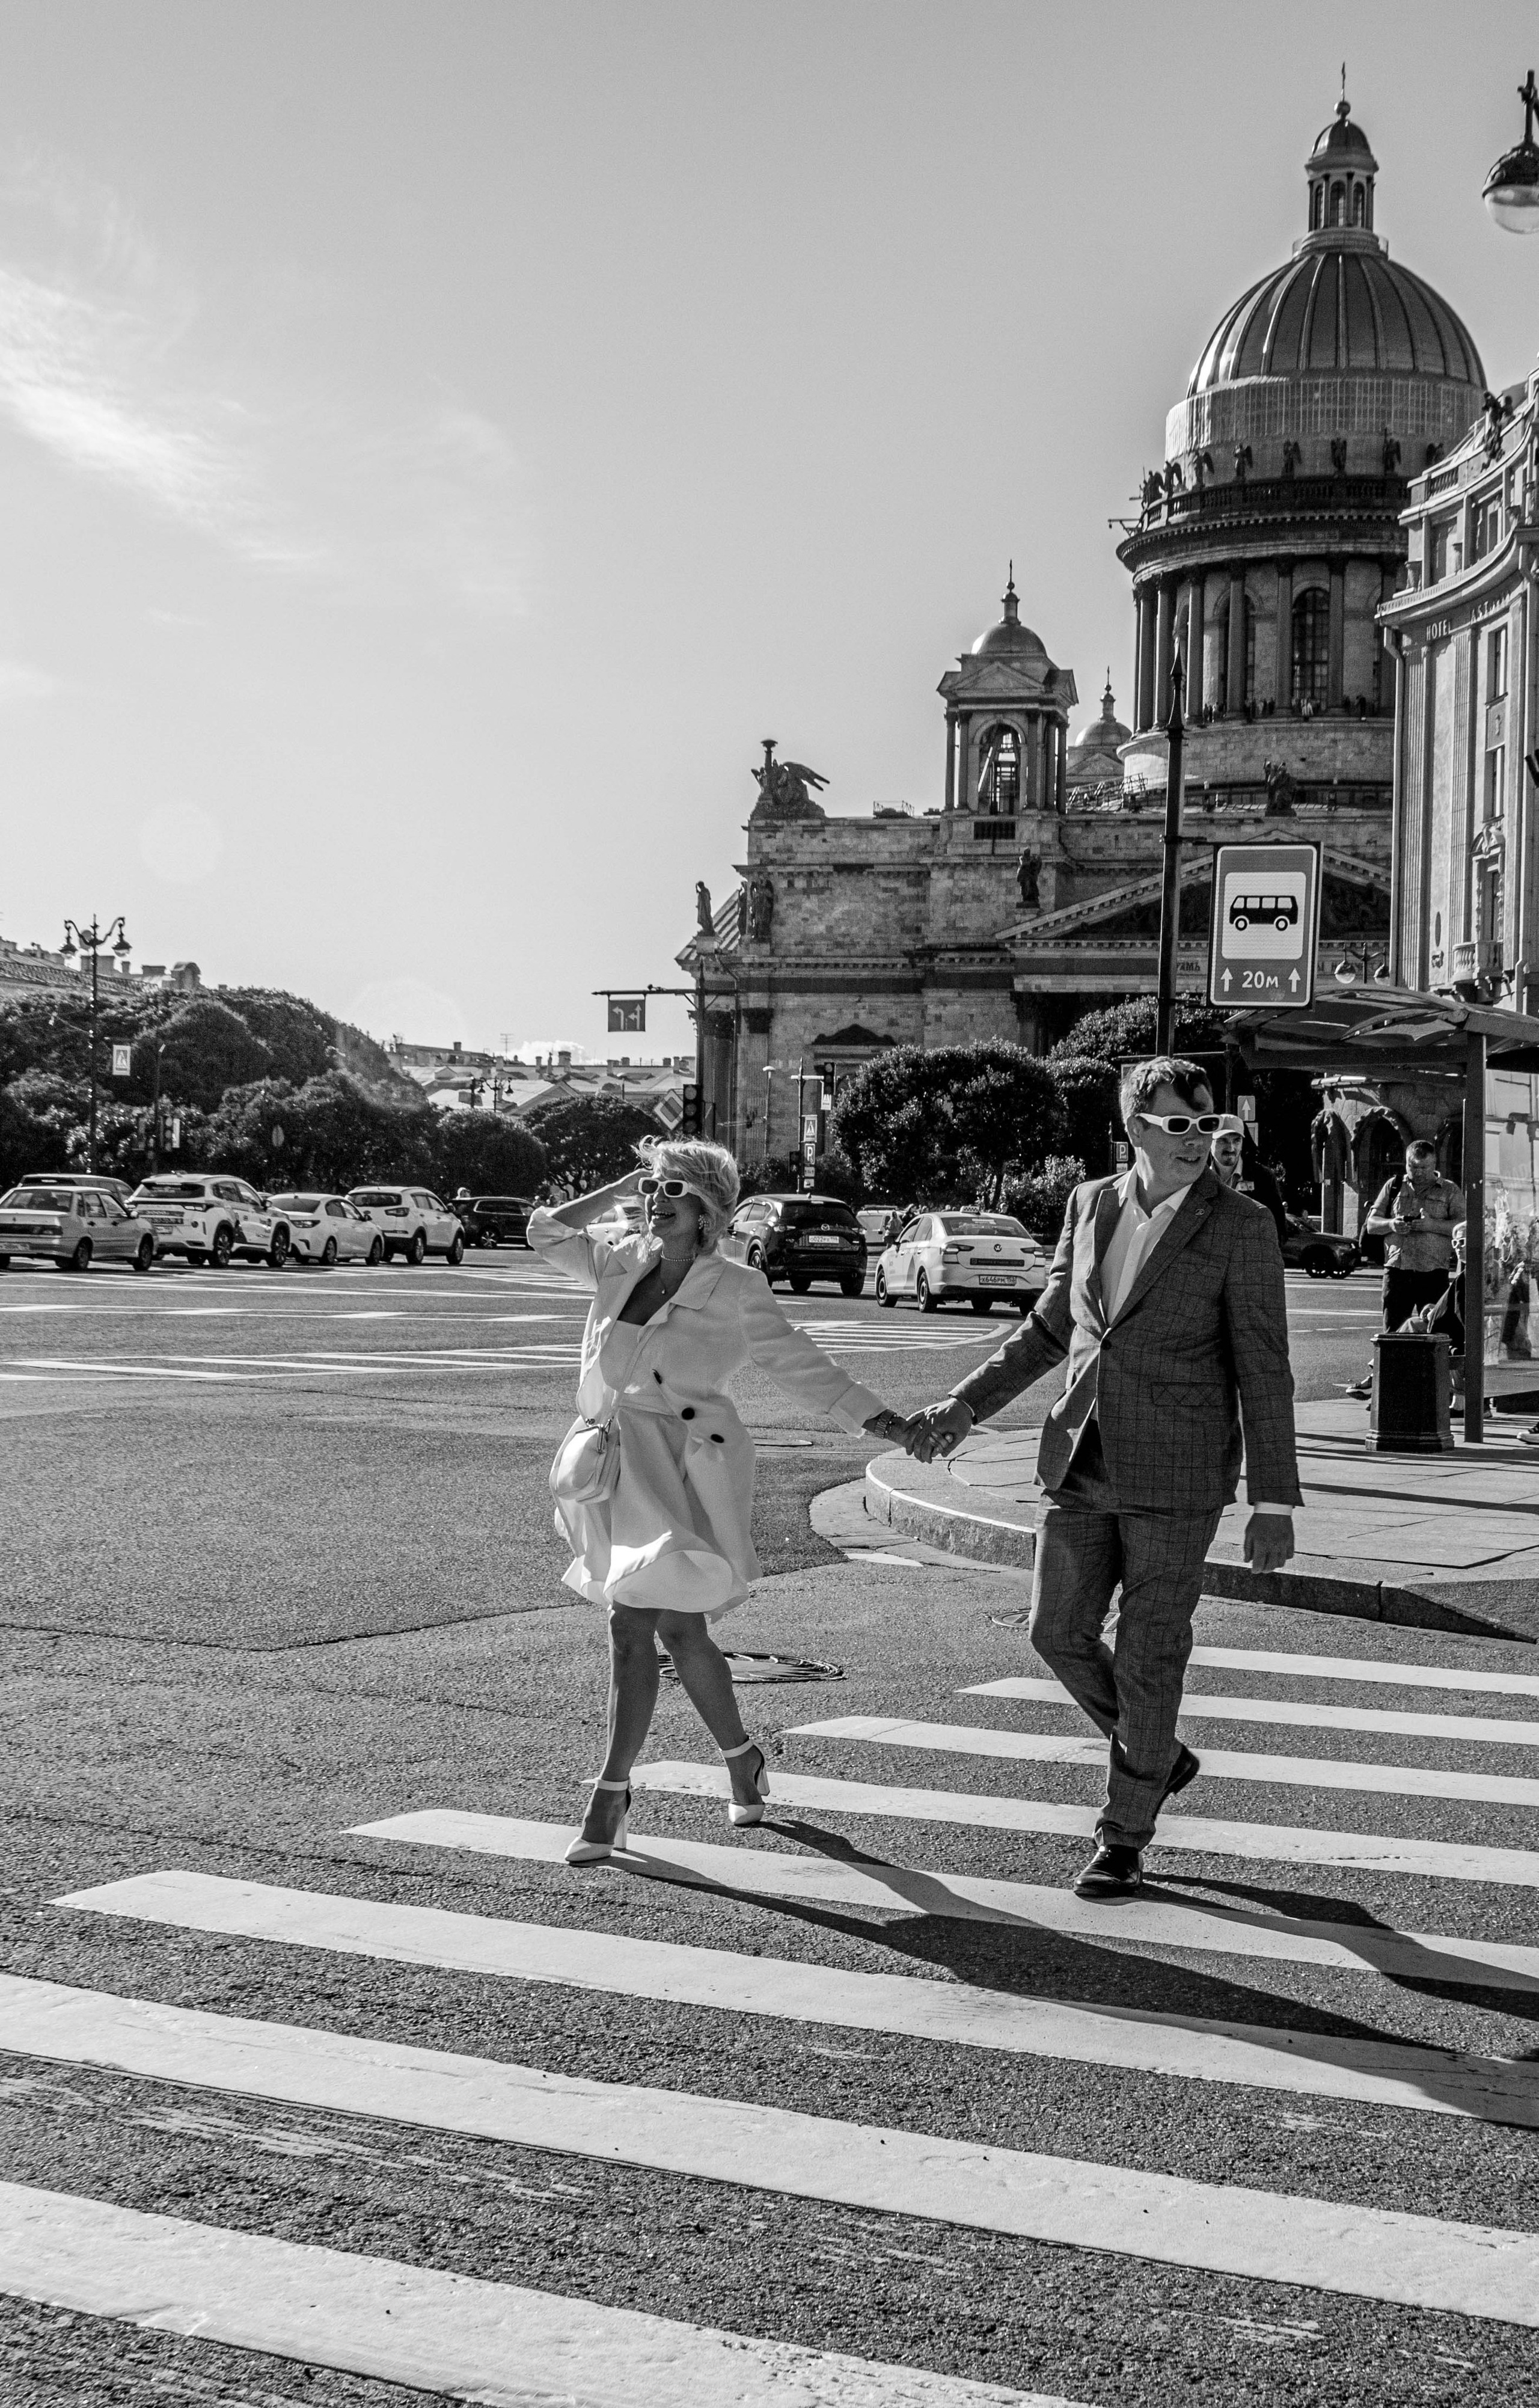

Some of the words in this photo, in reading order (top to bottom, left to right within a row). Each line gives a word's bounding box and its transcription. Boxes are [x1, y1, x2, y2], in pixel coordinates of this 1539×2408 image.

[1427, 618, 1451, 641] HOTEL
[807, 1146, 813, 1162] P
[1119, 1145, 1126, 1159] P
